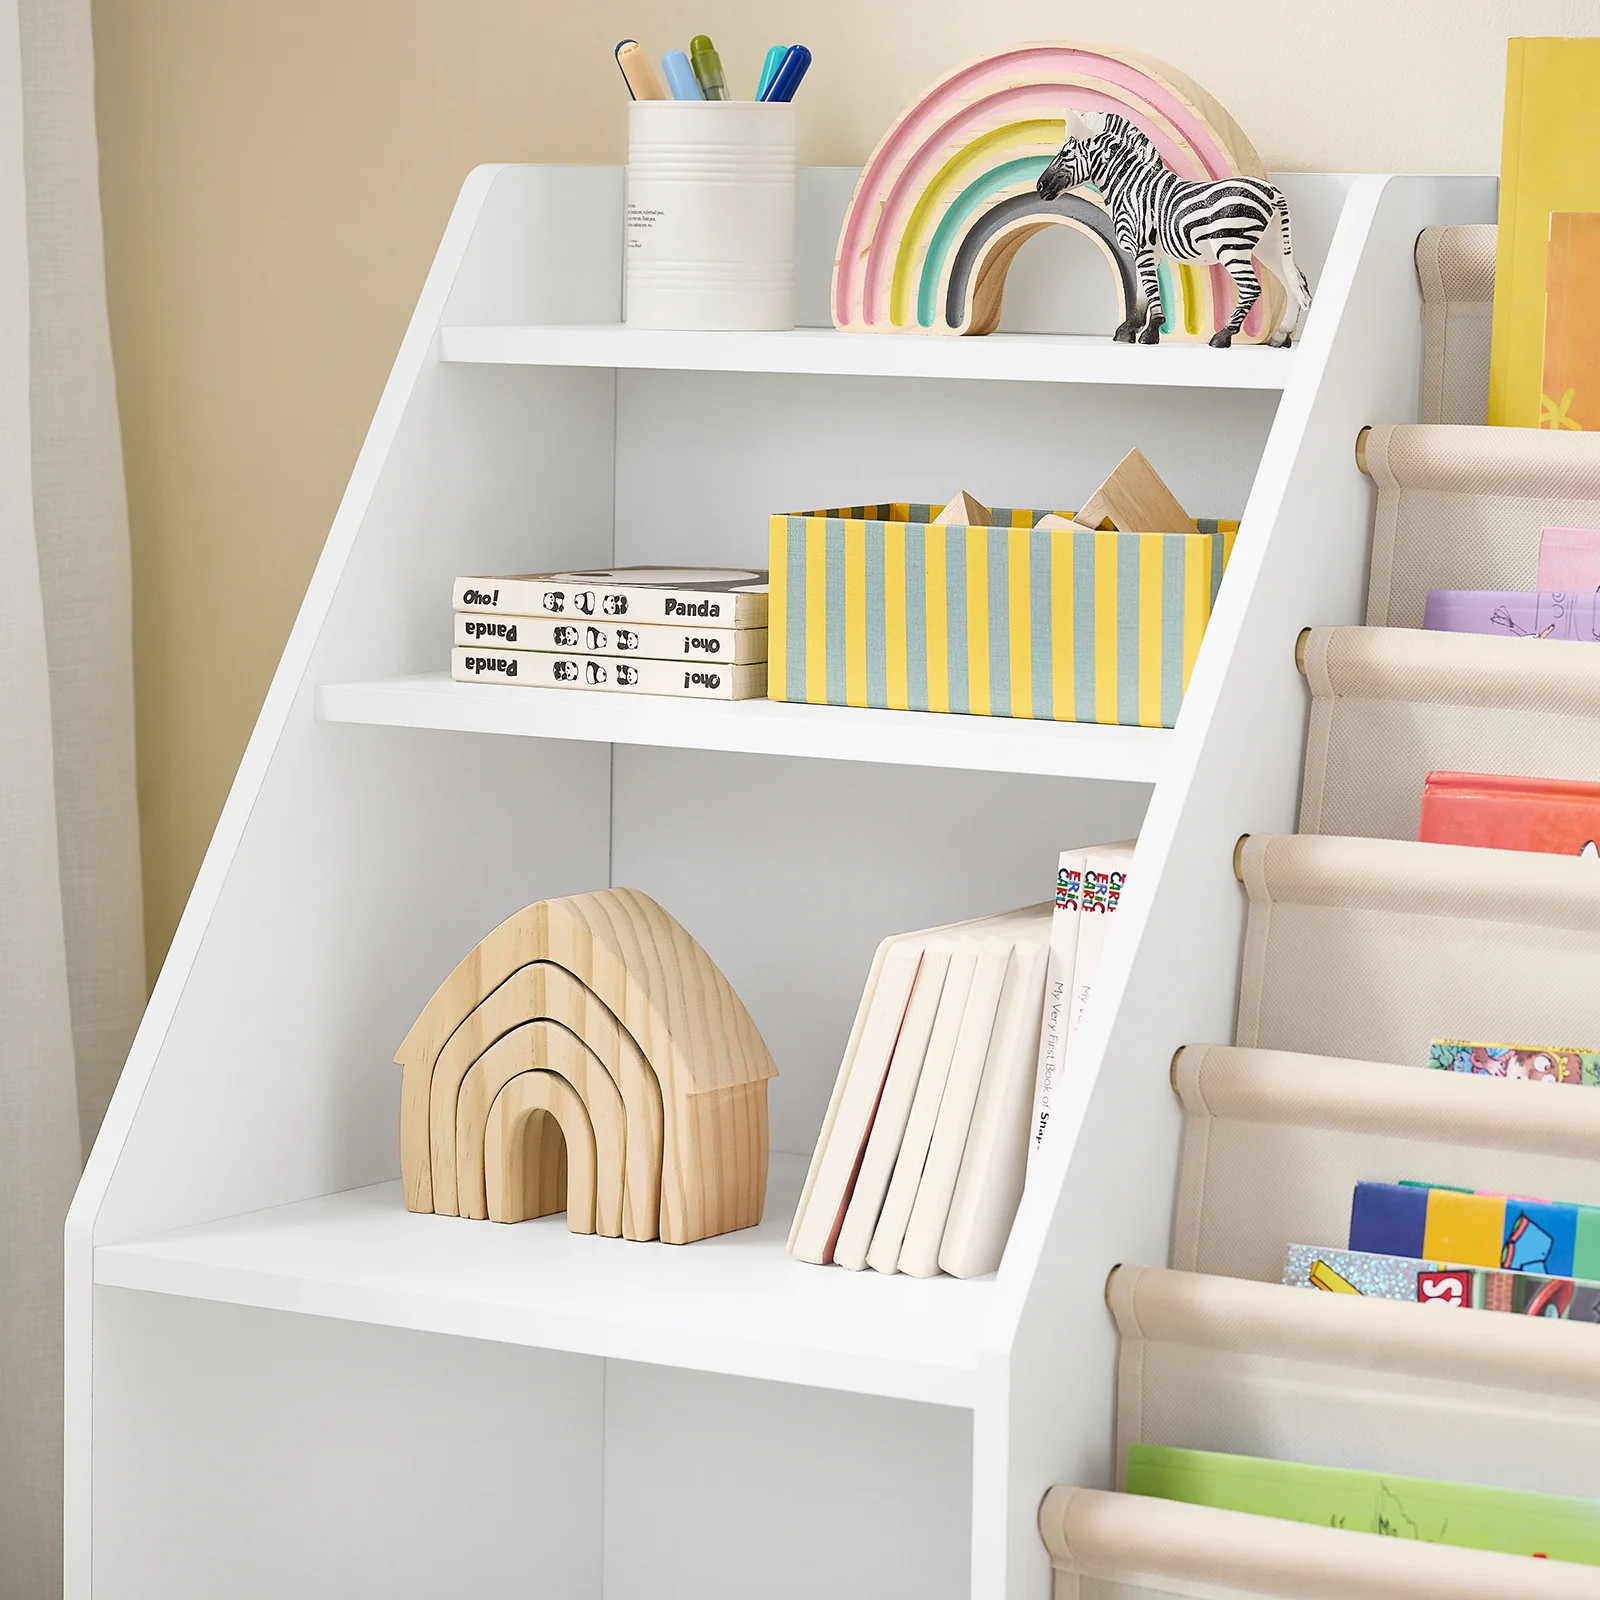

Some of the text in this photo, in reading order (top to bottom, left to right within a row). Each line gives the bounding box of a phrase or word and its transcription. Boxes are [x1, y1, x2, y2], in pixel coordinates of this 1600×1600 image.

[463, 589, 720, 617] Oho! Panda
[465, 622, 720, 653] Oho! Panda
[465, 657, 721, 689] Oho! Panda
[1054, 867, 1070, 910] CARLE
[1081, 870, 1097, 913] CARLE
[1051, 981, 1064, 1001] My
[1078, 985, 1091, 1004] My
[1047, 1003, 1062, 1032] Very
[1047, 1032, 1059, 1060] First
[1043, 1062, 1056, 1093] Book
[1041, 1094, 1051, 1109] of
